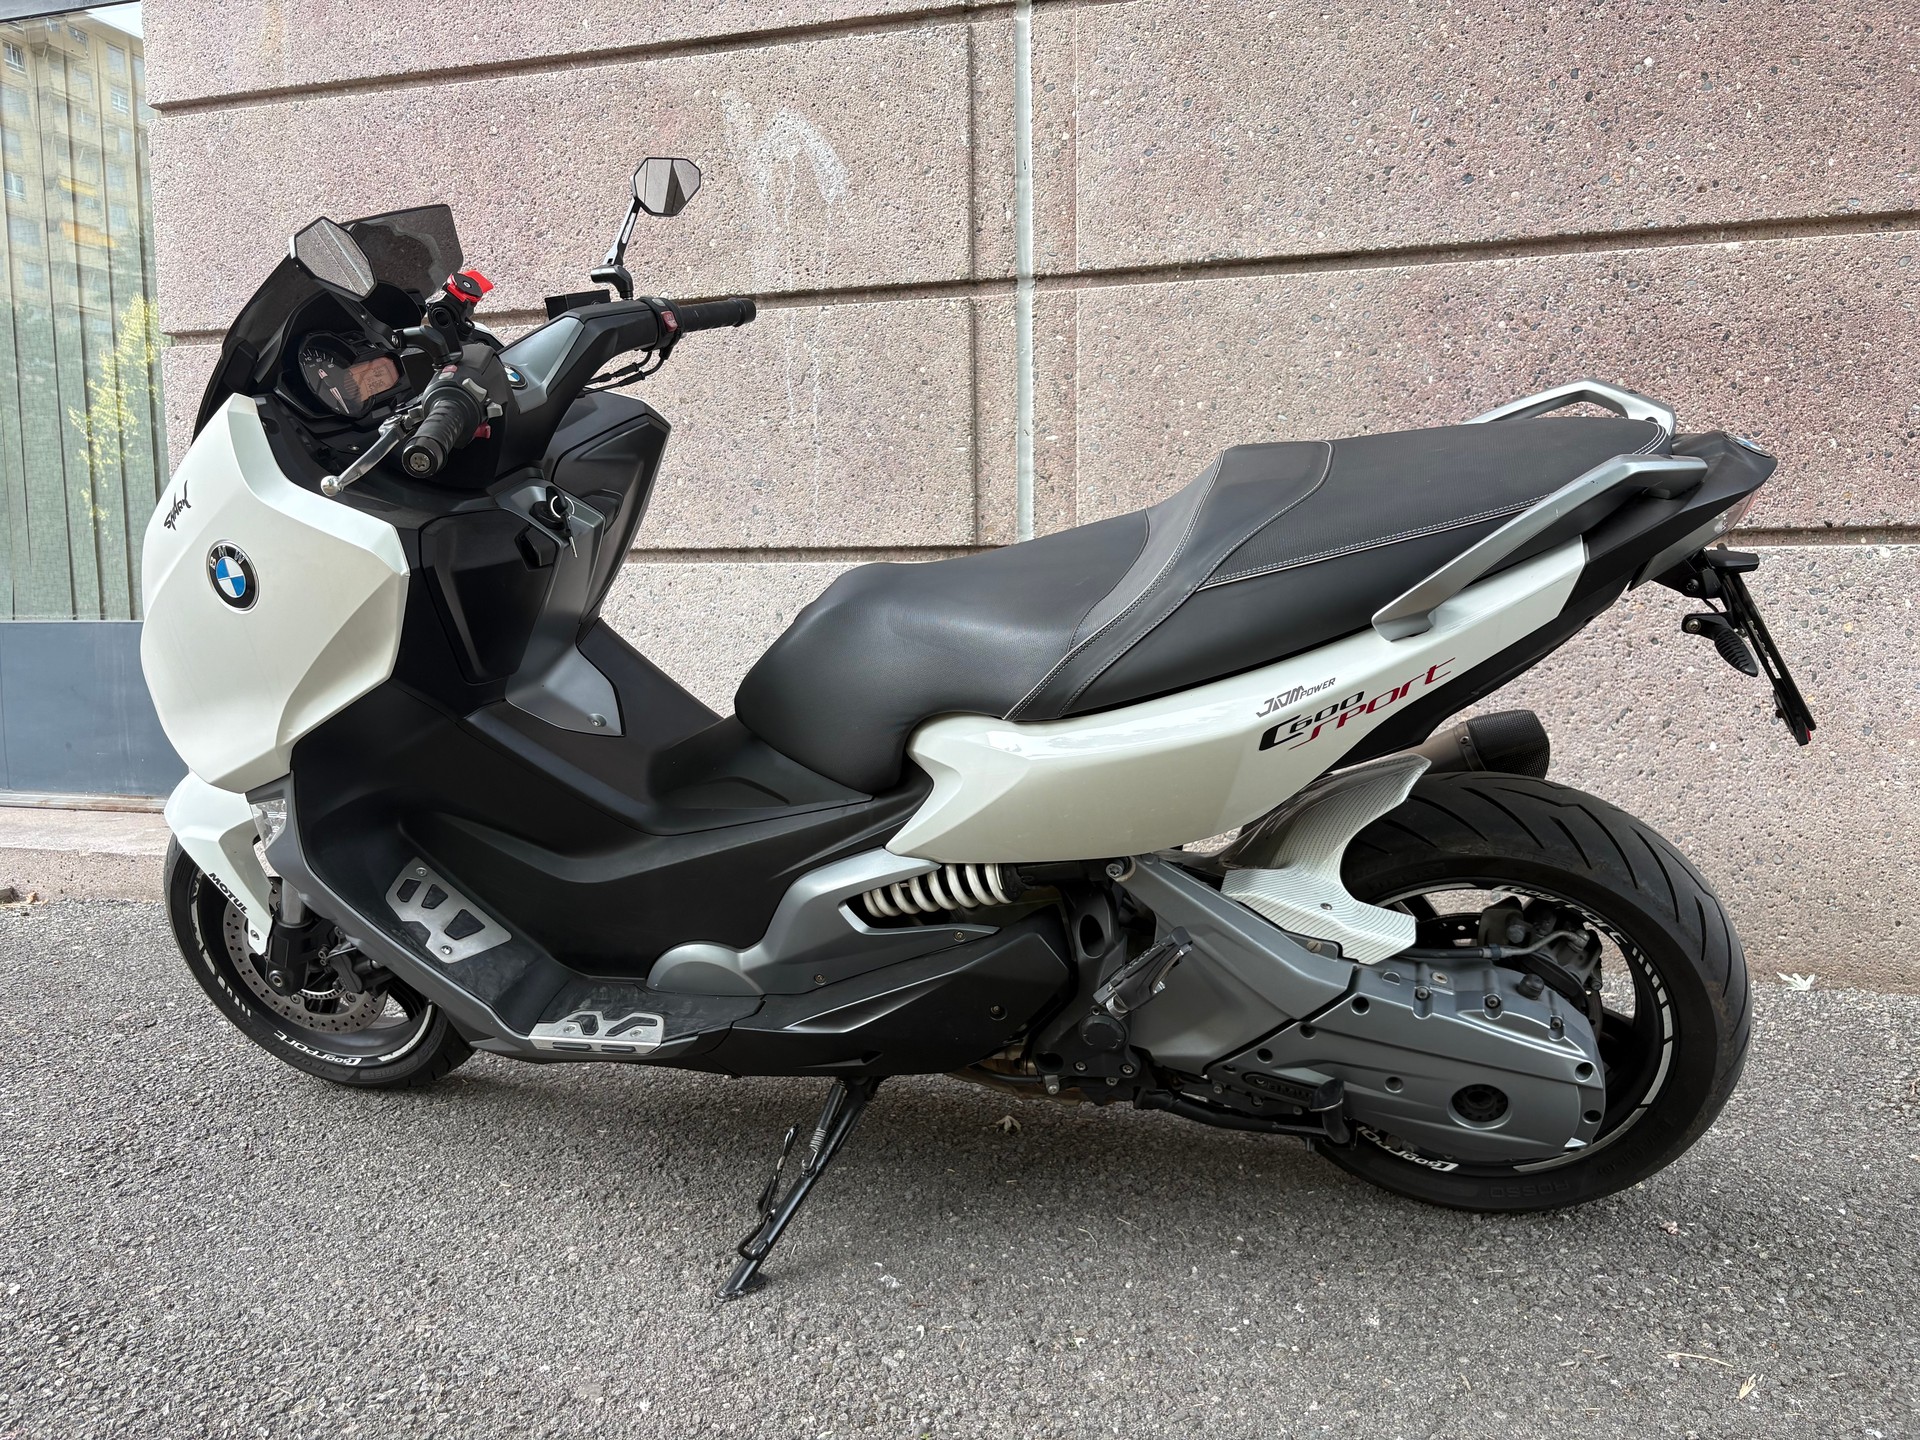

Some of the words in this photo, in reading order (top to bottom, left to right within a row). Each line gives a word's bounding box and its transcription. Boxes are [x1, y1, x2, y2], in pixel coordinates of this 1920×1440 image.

[210, 545, 245, 570] BMW
[1299, 677, 1336, 699] POWER
[1258, 690, 1364, 751] C600
[209, 872, 248, 914] MOTUL
